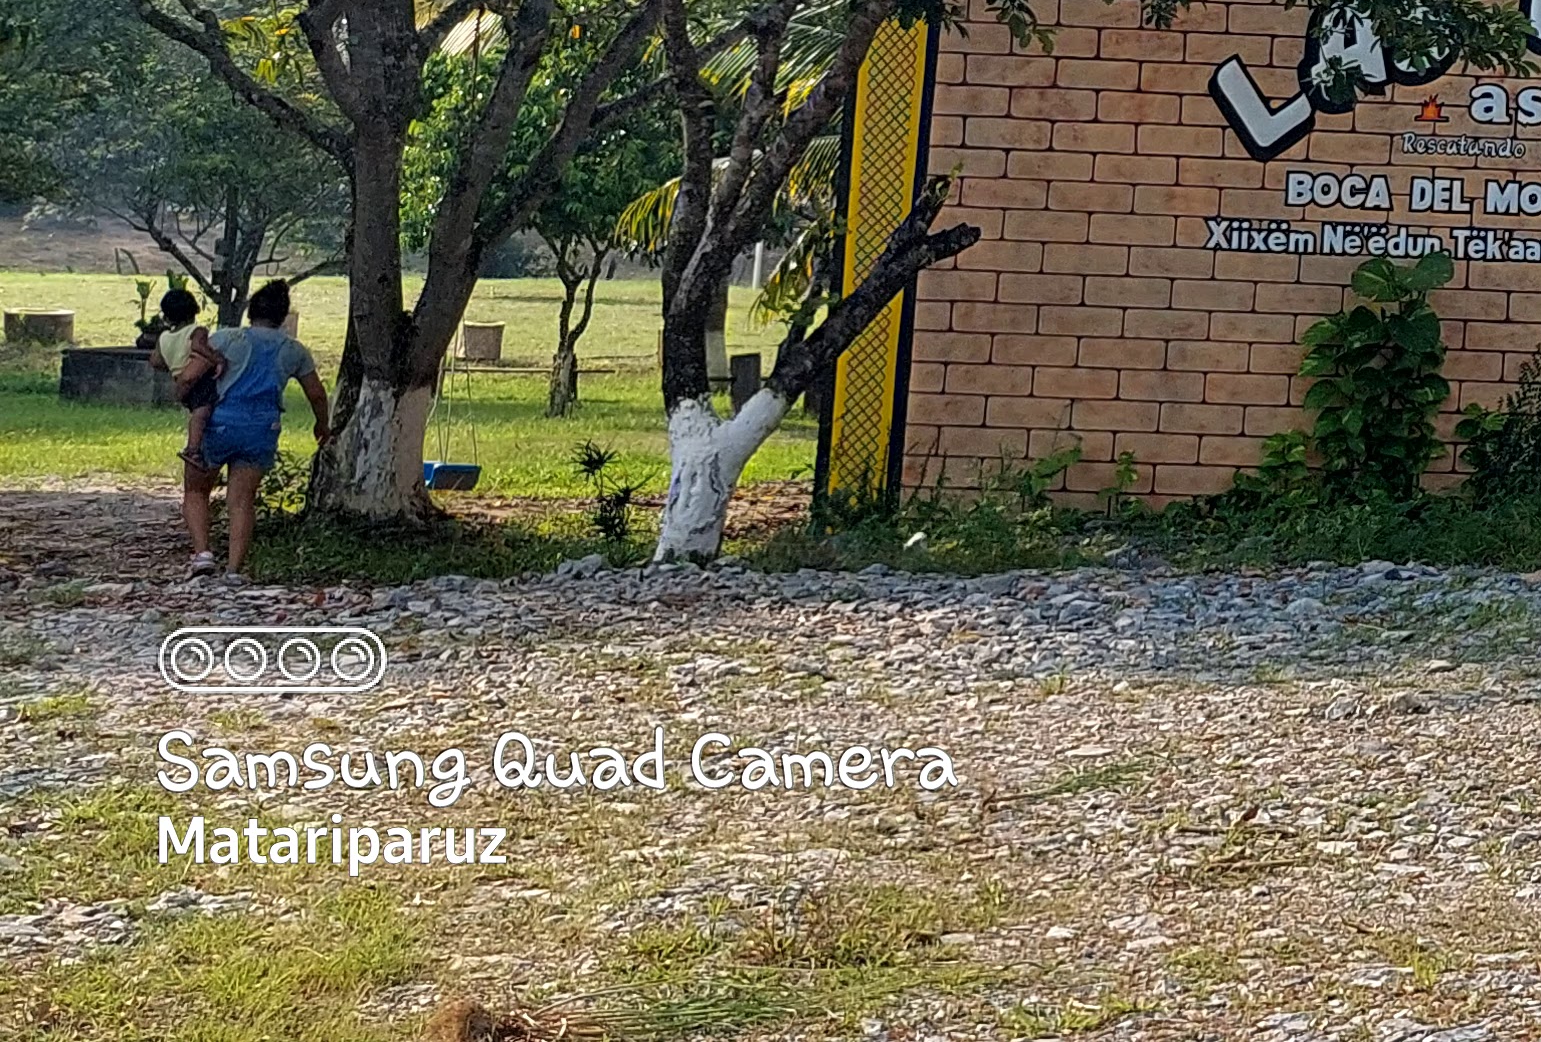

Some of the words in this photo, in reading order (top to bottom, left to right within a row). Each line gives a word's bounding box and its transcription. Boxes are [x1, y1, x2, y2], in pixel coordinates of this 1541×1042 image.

[1400, 131, 1526, 160] Rescatando
[1285, 170, 1394, 211] BOCA
[1409, 176, 1471, 214] DEL
[1203, 218, 1317, 256] Xiixëm
